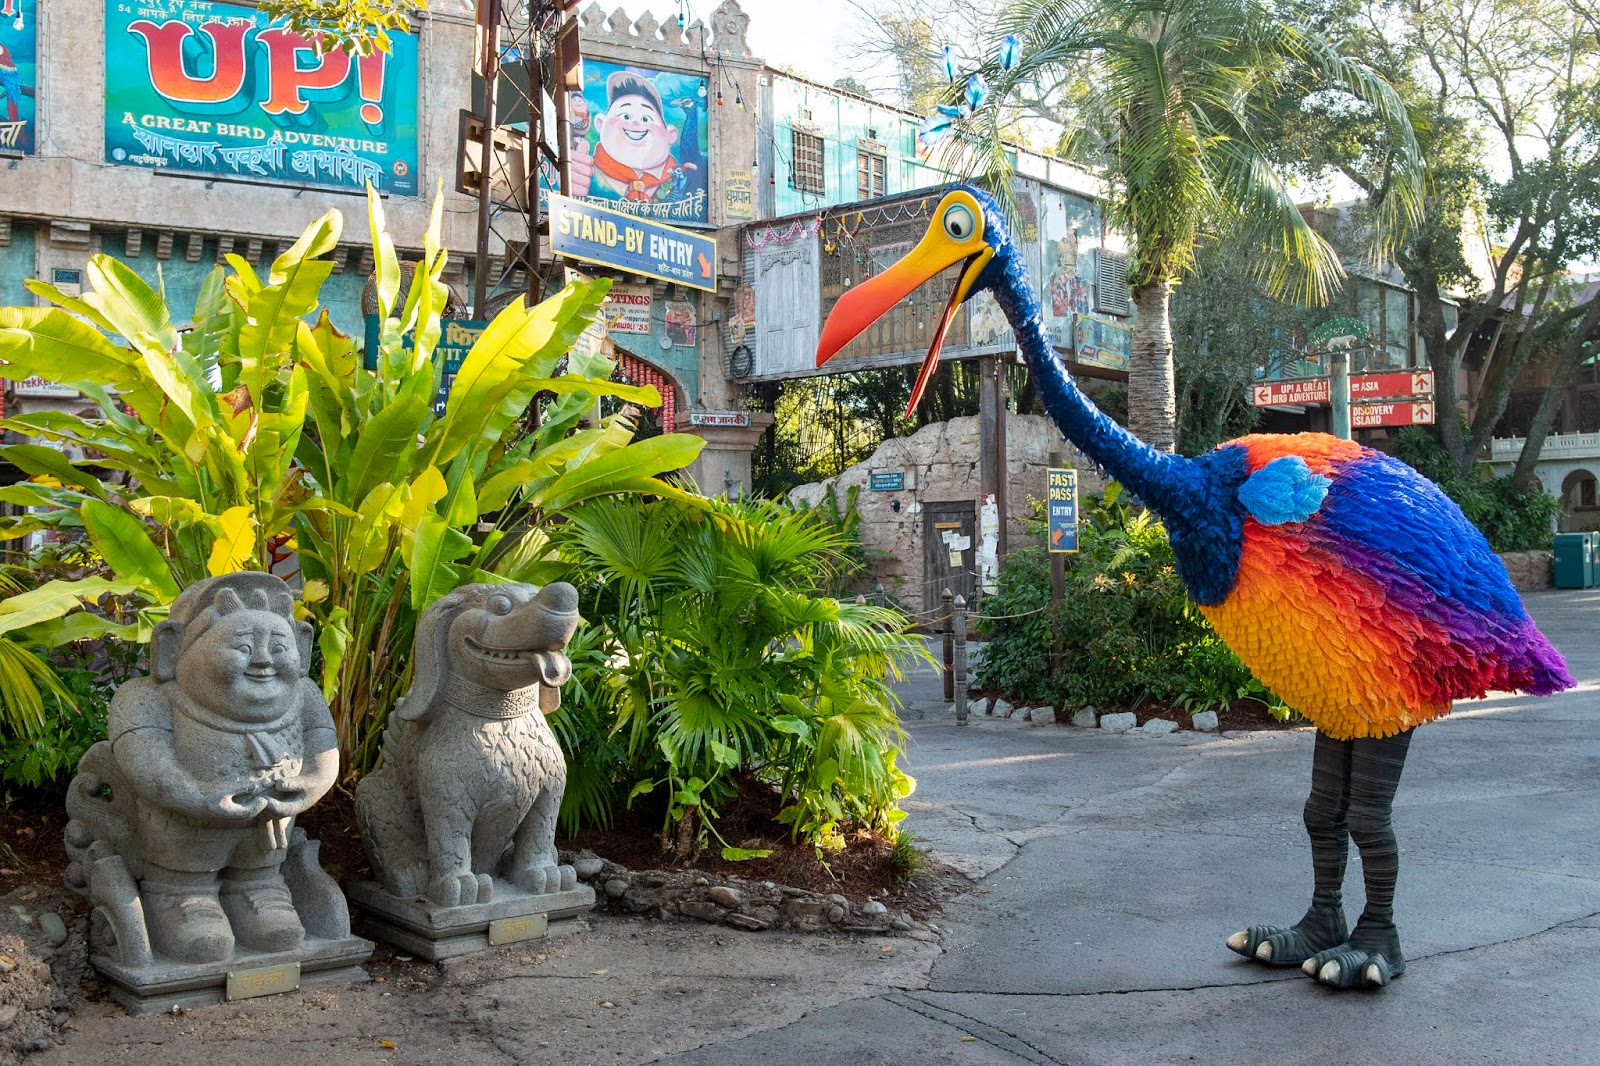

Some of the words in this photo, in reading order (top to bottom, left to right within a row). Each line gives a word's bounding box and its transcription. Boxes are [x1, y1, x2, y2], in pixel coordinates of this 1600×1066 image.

[118, 4, 131, 13] 54
[137, 7, 169, 20] आपके
[126, 19, 392, 125] UP!
[122, 111, 137, 125] A
[141, 114, 212, 134] GREAT
[216, 122, 266, 139] BIRD
[272, 129, 389, 154] ADVENTURE
[558, 208, 645, 255] STAND-BY
[650, 234, 694, 267] ENTRY
[1280, 384, 1294, 393] UP!
[1296, 383, 1302, 392] A
[1303, 381, 1328, 392] GREAT
[1360, 381, 1379, 392] ASIA
[1272, 394, 1288, 404] BIRD
[1289, 391, 1328, 402] ADVENTURE
[1353, 404, 1394, 416] DISCOVERY
[1353, 415, 1382, 426] ISLAND
[1049, 474, 1073, 486] FAST
[1049, 488, 1072, 500] PASS
[1052, 506, 1072, 516] ENTRY
